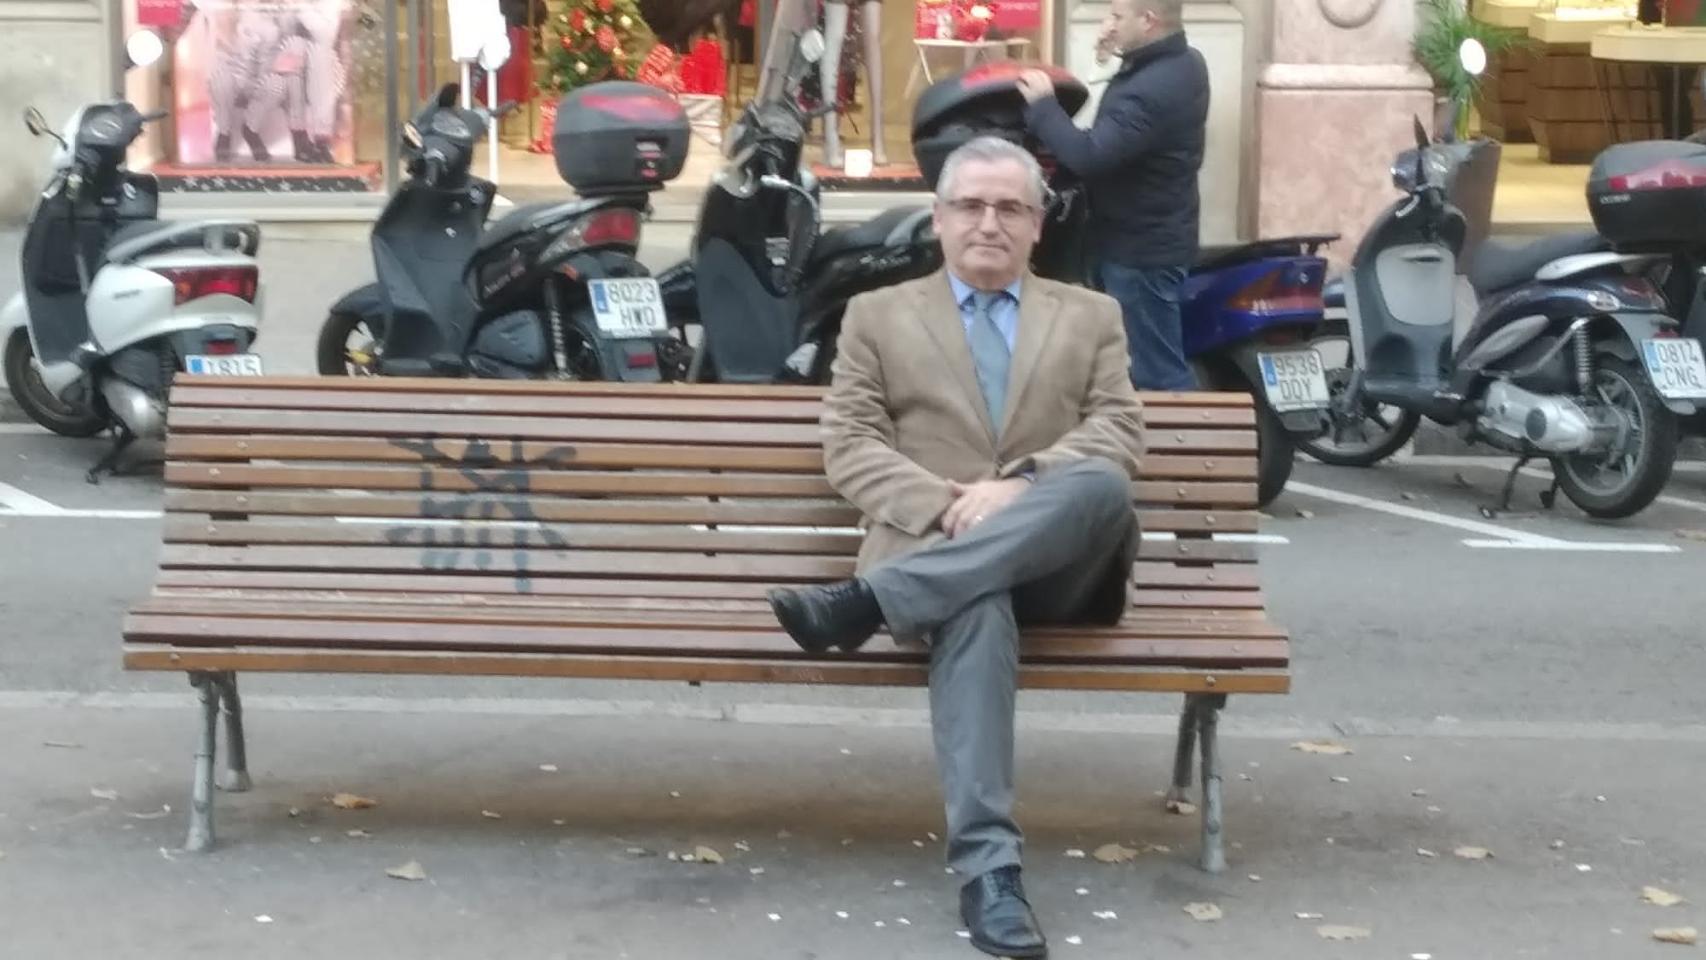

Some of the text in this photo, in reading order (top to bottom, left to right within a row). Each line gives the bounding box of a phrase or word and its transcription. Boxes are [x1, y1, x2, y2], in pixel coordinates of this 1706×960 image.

[608, 282, 657, 304] 8023
[1275, 355, 1319, 375] 9538
[1664, 366, 1700, 386] CNG
